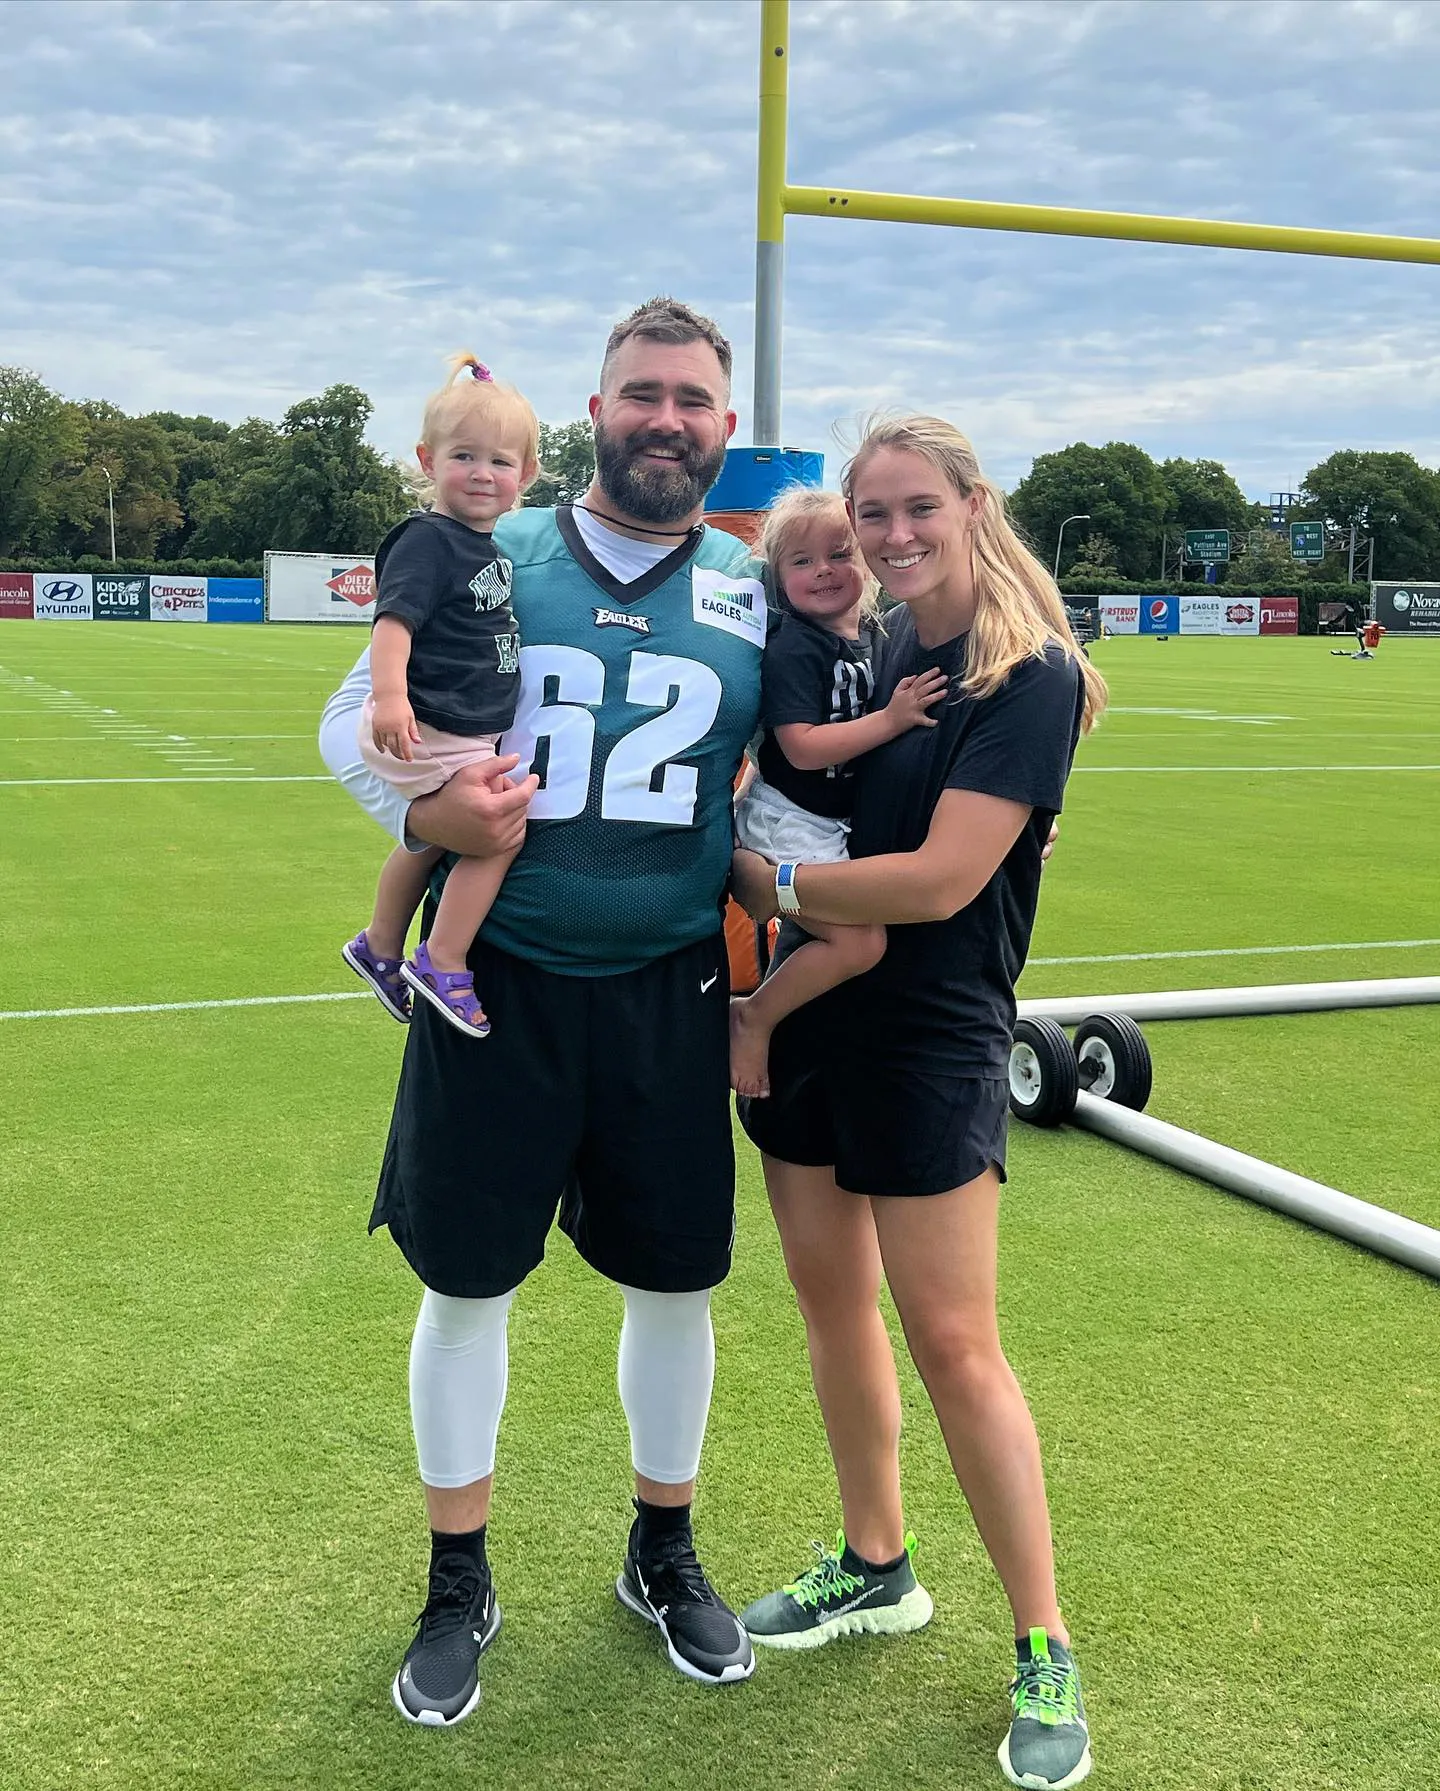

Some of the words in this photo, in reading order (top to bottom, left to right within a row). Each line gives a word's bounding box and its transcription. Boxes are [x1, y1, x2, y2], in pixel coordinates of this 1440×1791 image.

[97, 581, 125, 593] KIDS
[97, 593, 140, 606] CLUB
[208, 596, 253, 605] Independence
[1409, 593, 1440, 608] Nova
[37, 605, 90, 614] HYUNDAI
[701, 598, 742, 622] EAGLES
[594, 607, 650, 634] EAGLES
[499, 644, 723, 826] 62
